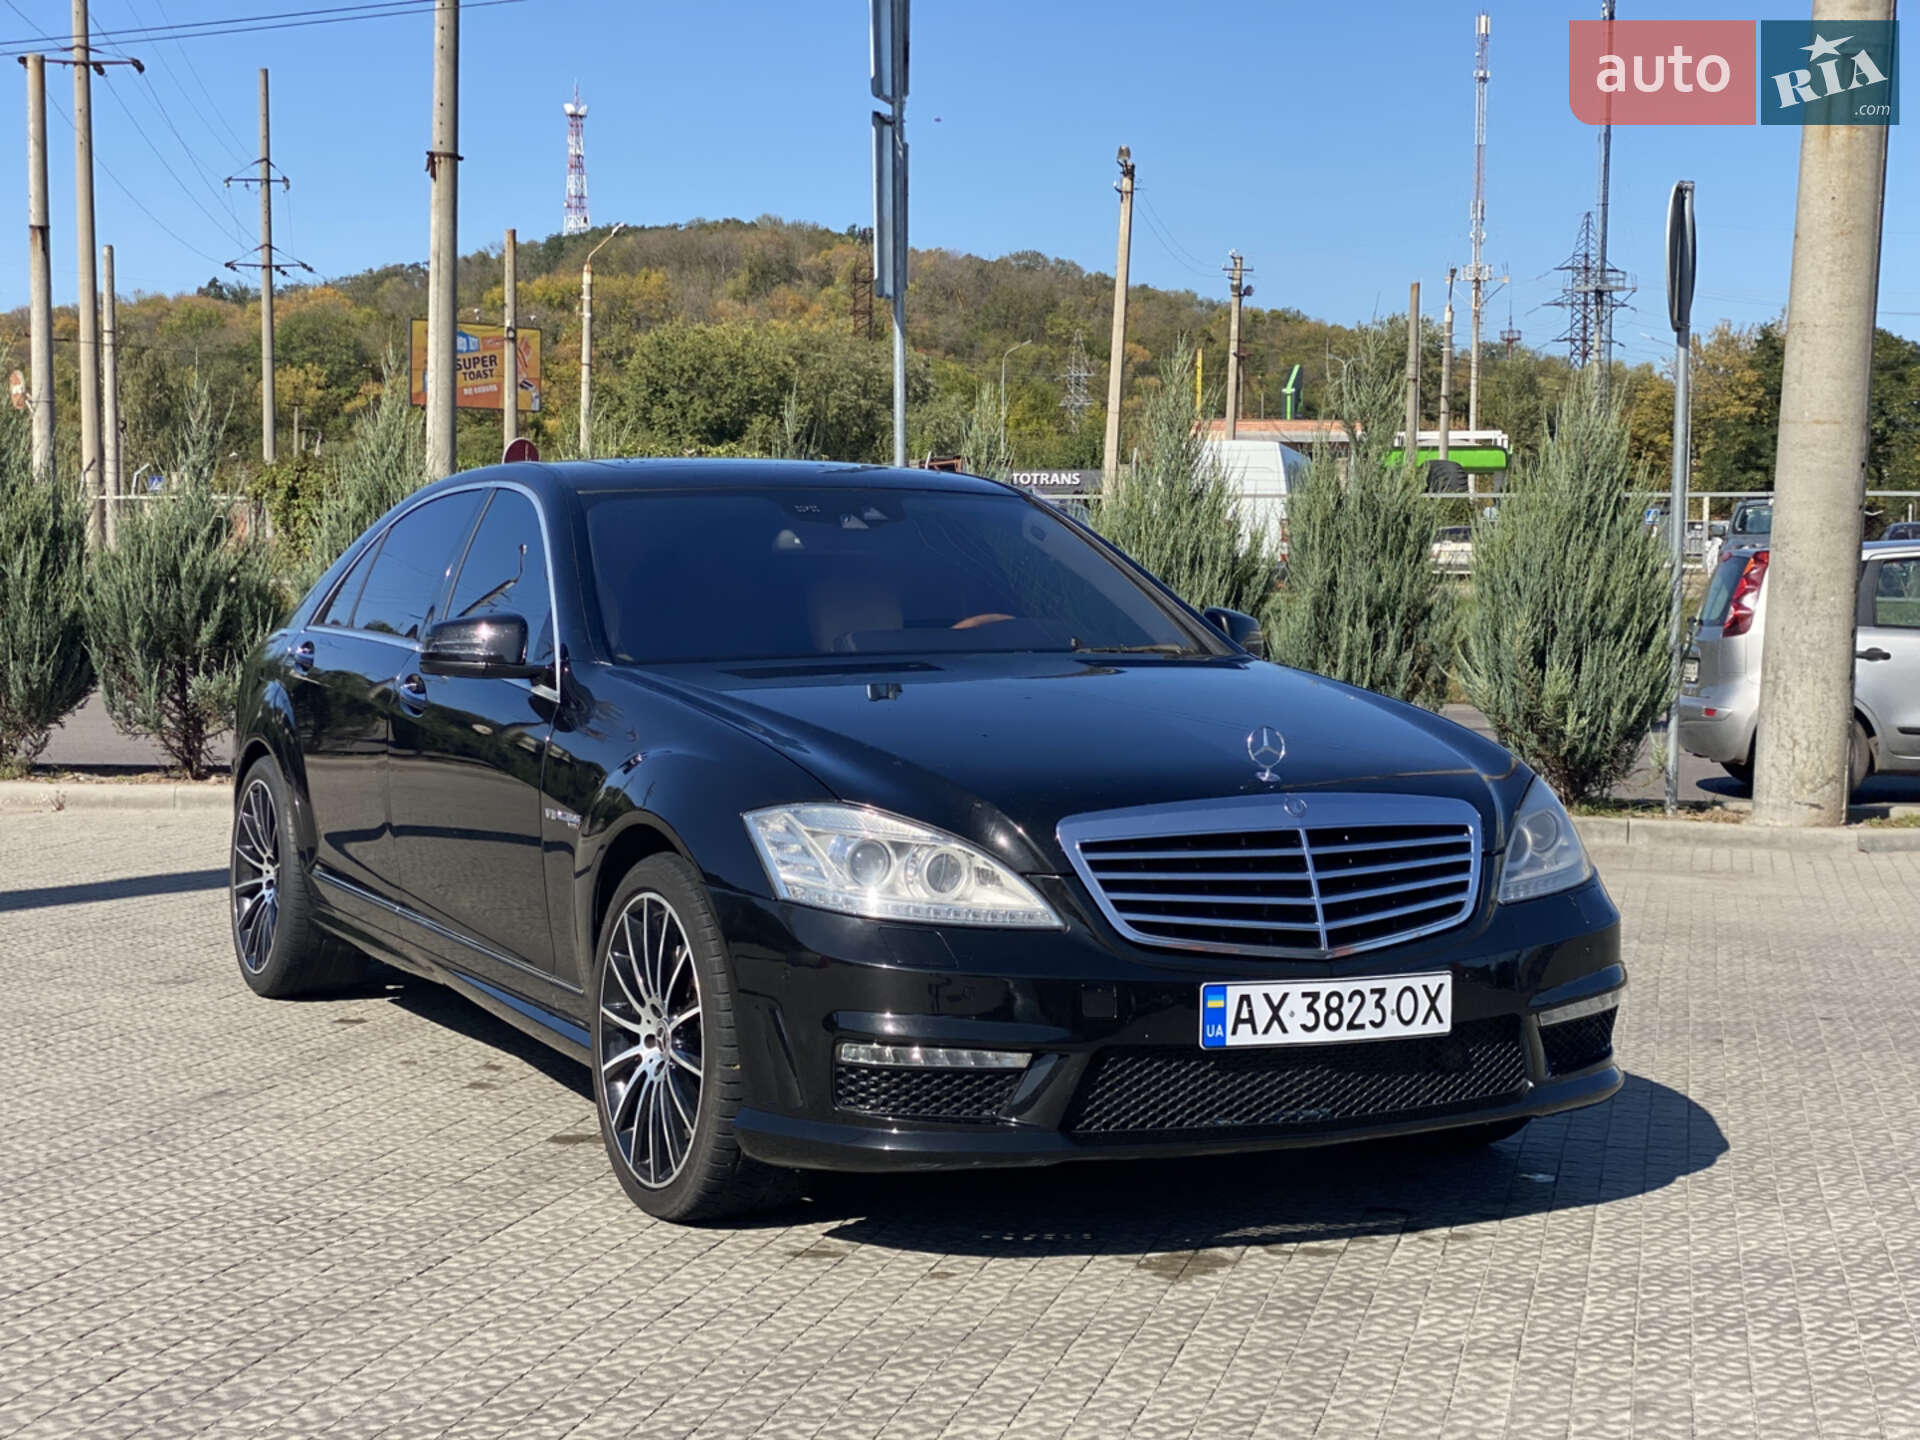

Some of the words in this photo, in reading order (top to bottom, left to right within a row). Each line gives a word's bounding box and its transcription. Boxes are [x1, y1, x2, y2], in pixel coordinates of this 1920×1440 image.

[456, 354, 497, 370] SUPER
[462, 368, 494, 381] TOAST
[1206, 1023, 1224, 1038] UA
